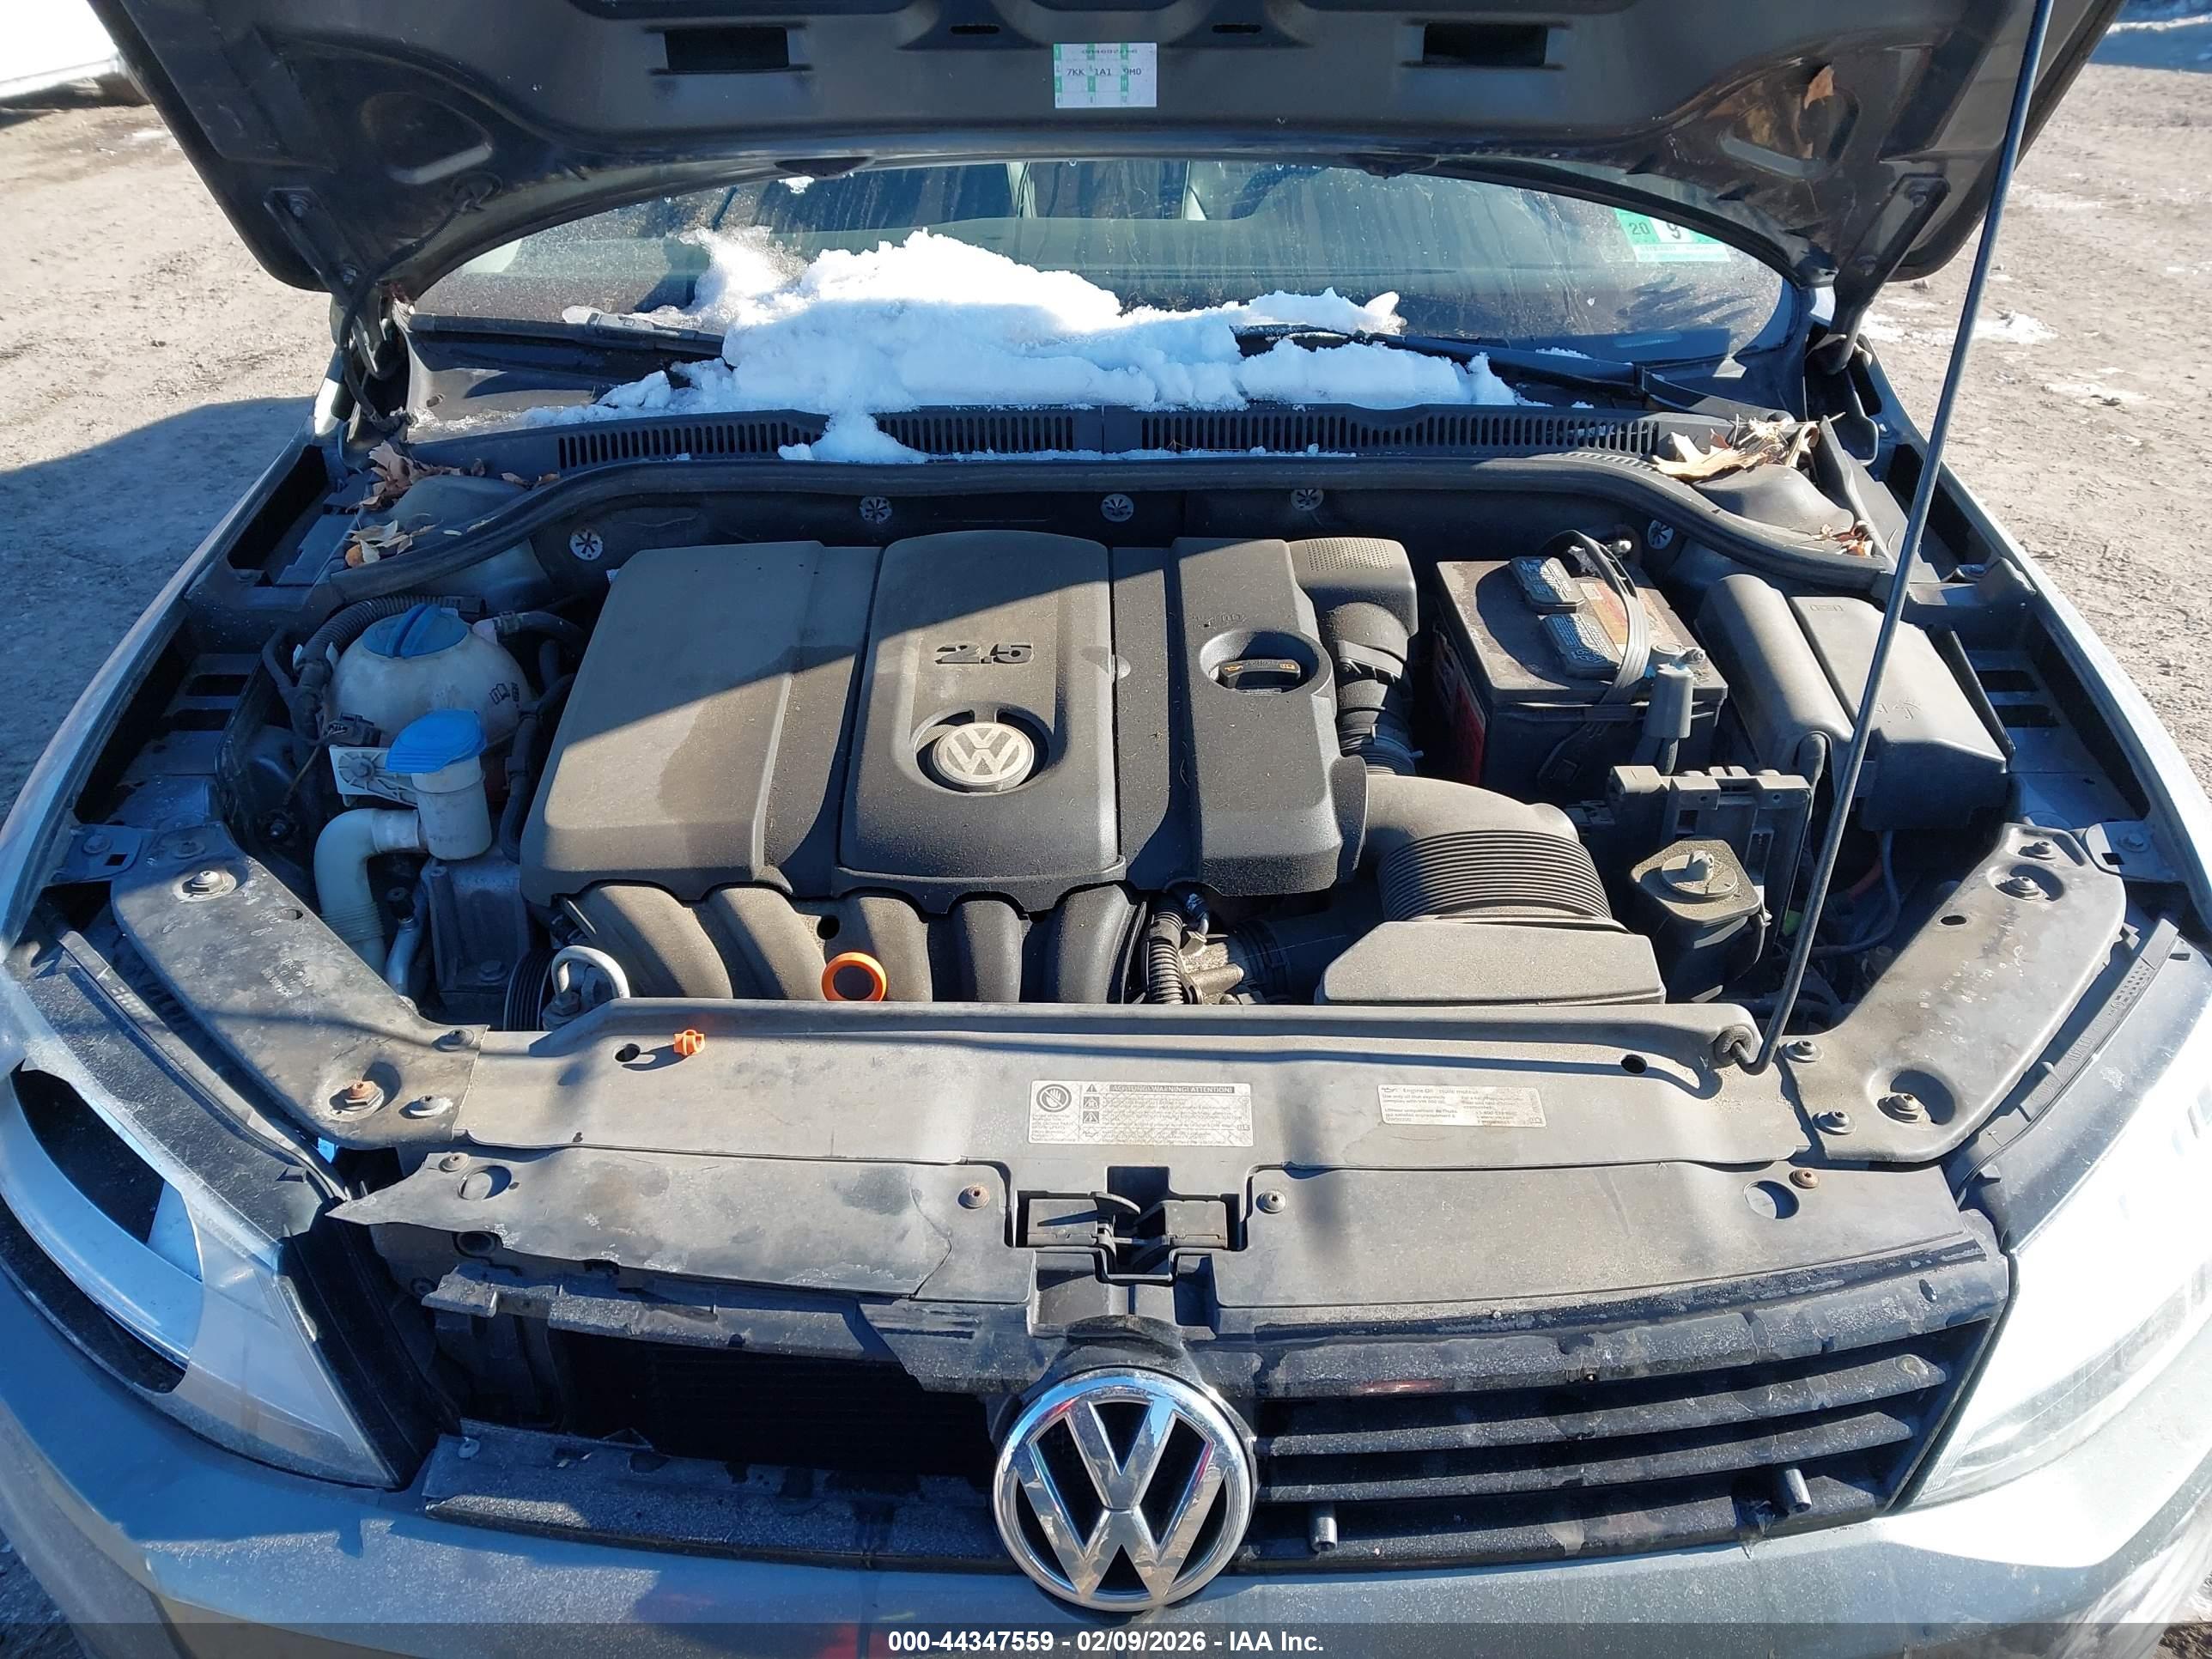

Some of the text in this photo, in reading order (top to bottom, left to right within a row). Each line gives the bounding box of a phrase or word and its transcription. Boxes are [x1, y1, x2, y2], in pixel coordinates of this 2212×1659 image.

[1066, 68, 1085, 76] 7KK
[1094, 68, 1112, 76] 1A1
[1628, 222, 1650, 235] 20
[934, 642, 1034, 665] 2.5
